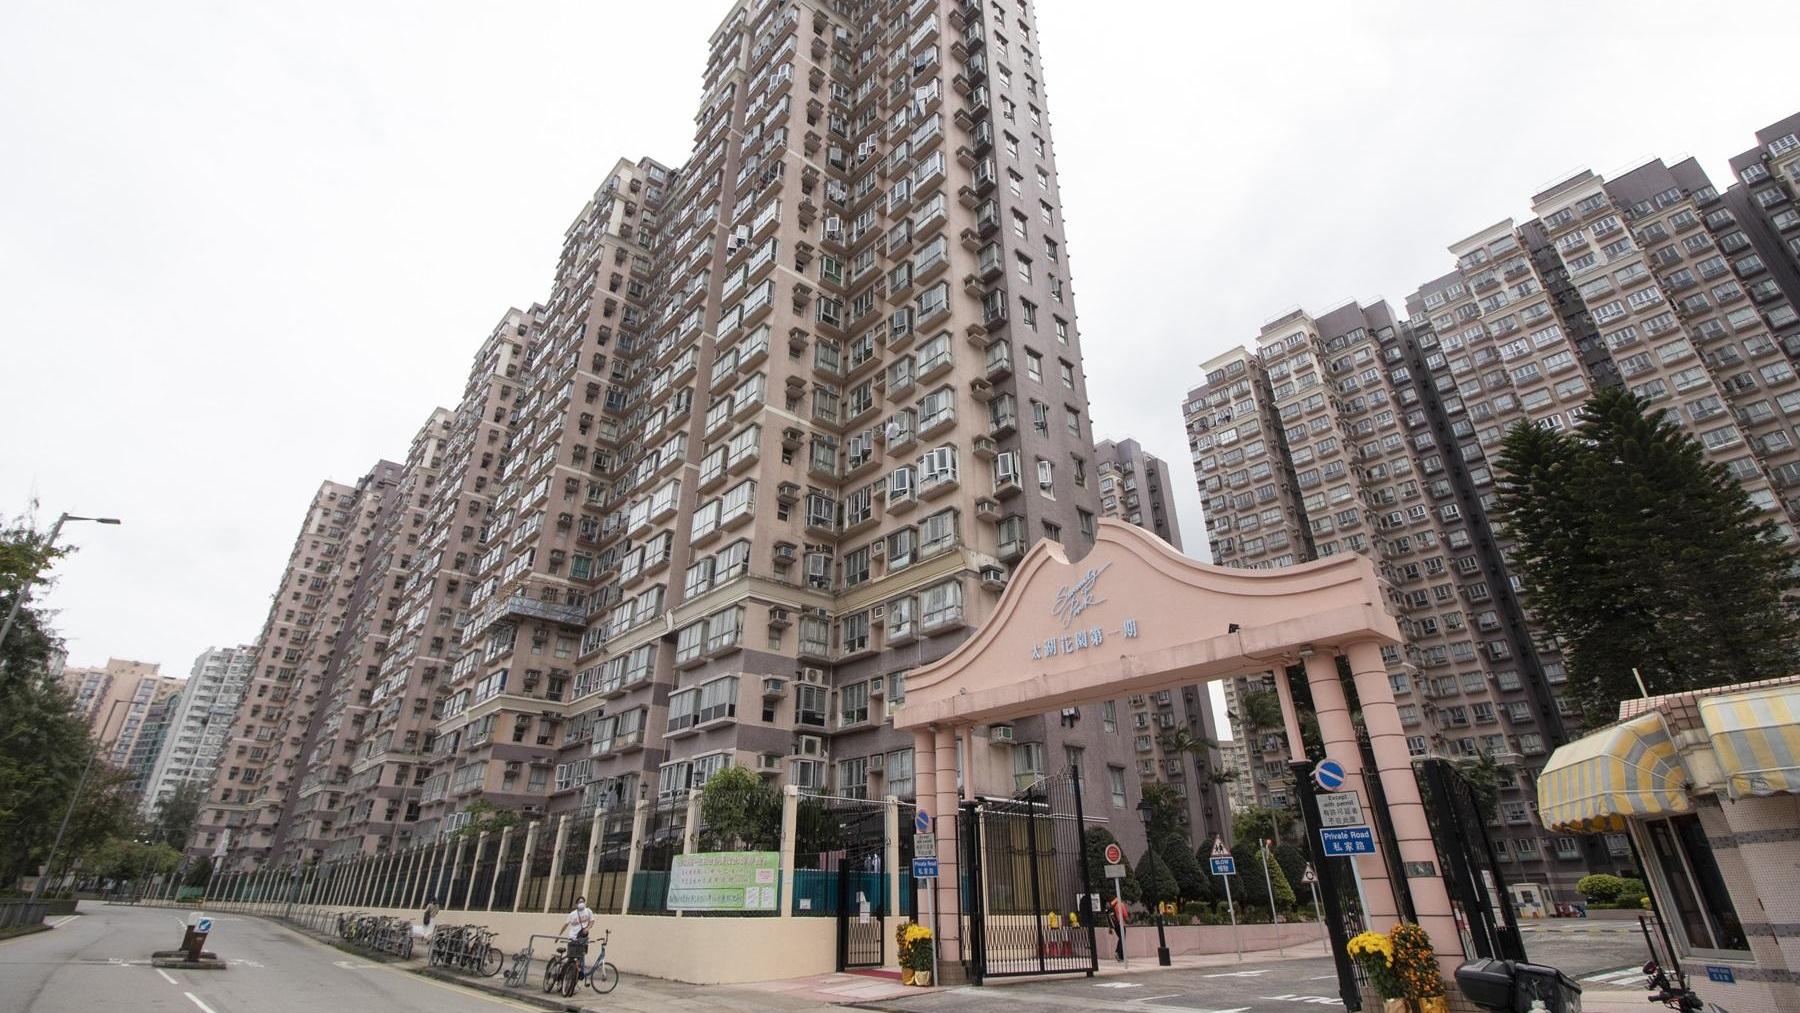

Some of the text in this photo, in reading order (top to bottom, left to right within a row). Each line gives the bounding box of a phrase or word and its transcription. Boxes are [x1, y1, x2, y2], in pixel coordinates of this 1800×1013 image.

[1032, 618, 1137, 660] 太湖花園第一期
[1324, 831, 1370, 841] Private Road
